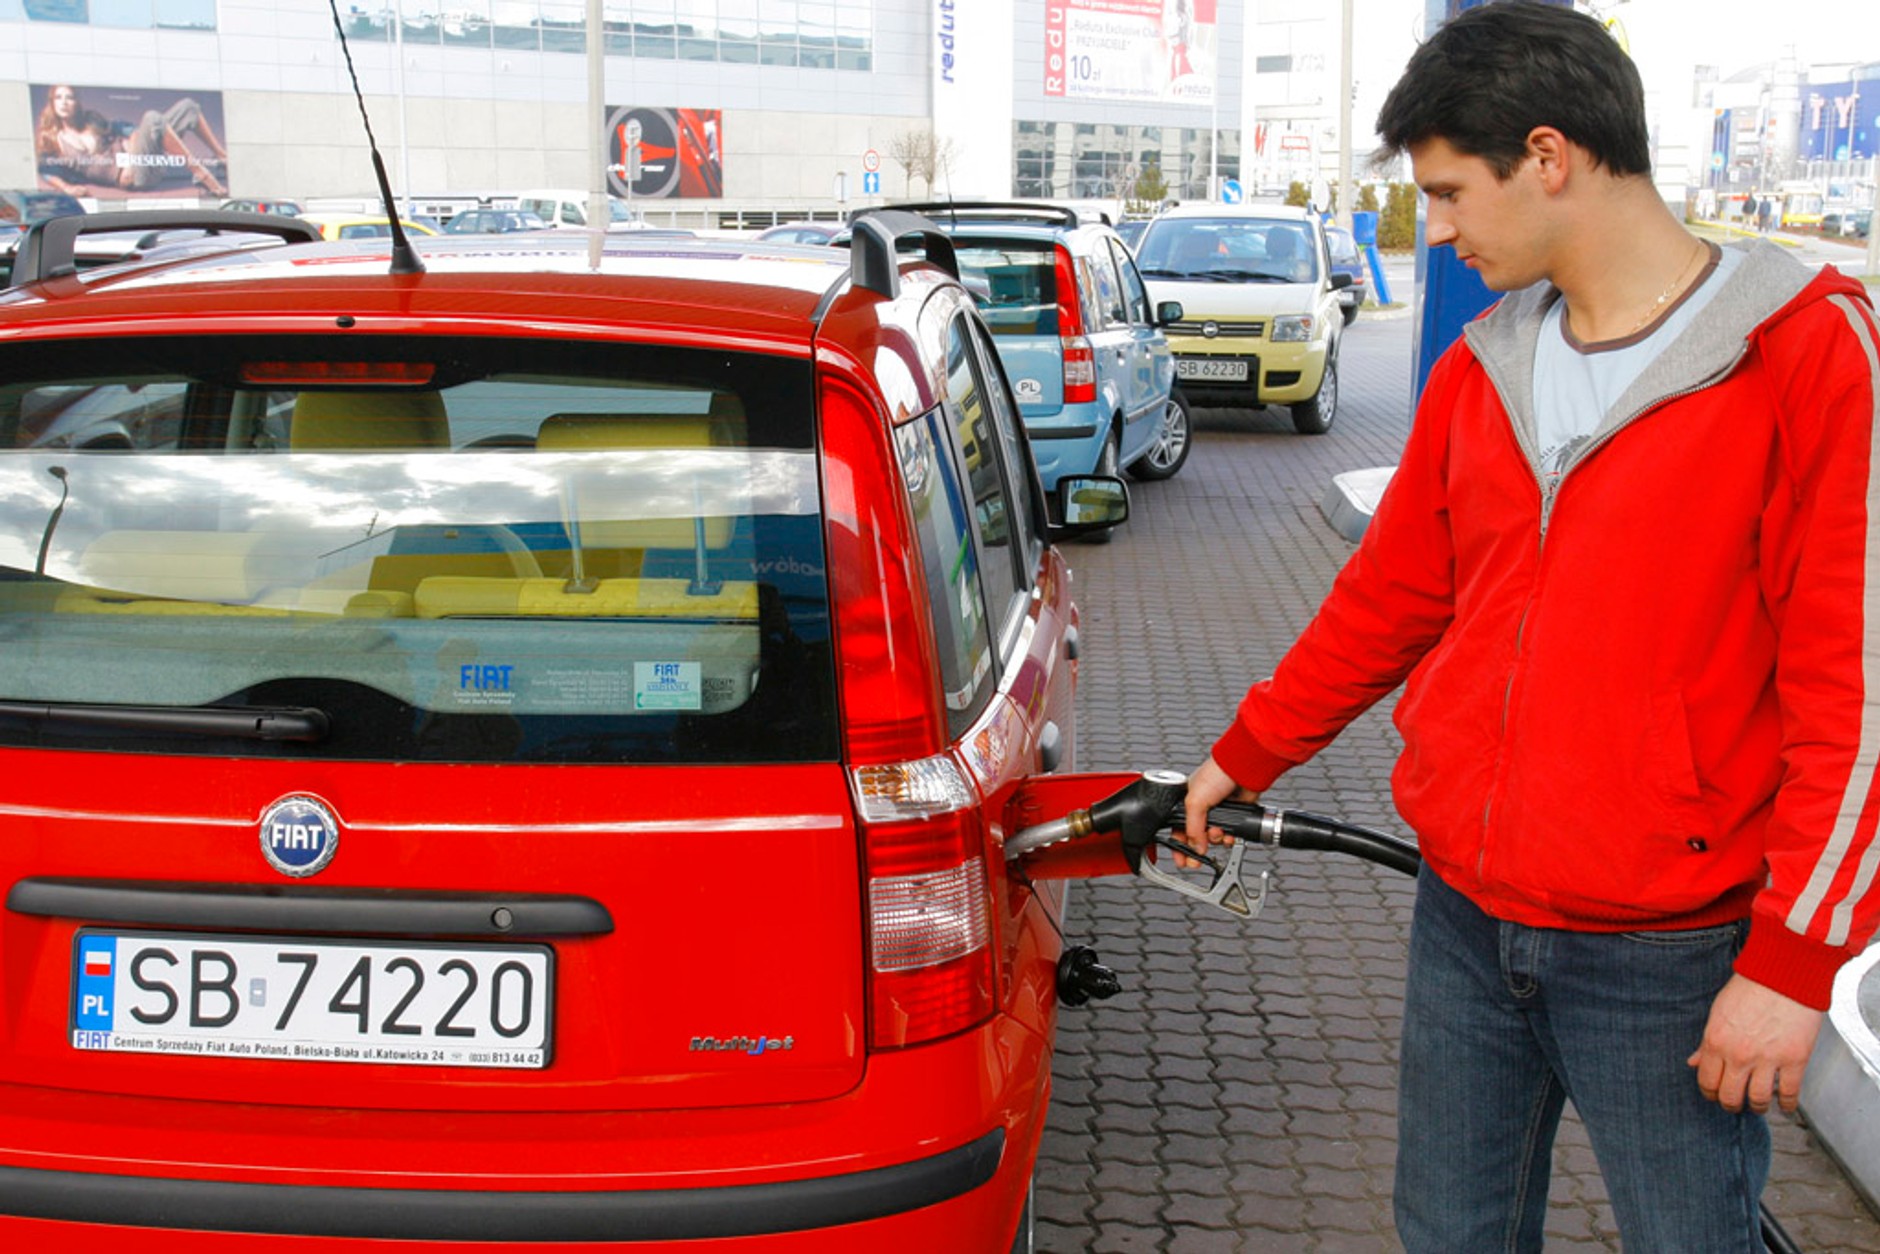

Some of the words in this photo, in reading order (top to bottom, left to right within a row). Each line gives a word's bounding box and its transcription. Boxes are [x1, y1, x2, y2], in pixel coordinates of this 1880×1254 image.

[1070, 54, 1092, 81] 10
[129, 155, 185, 166] RESERVED
[1178, 361, 1198, 375] SB
[1202, 363, 1246, 377] 62230
[1020, 382, 1036, 392] PL
[460, 664, 514, 690] FIAT
[654, 664, 680, 676] FIAT
[271, 824, 323, 849] FIAT
[130, 947, 240, 1028] SB
[275, 952, 533, 1038] 74220
[82, 995, 109, 1016] PL
[76, 1031, 111, 1049] FIAT
[114, 1036, 154, 1047] Centrum
[207, 1041, 225, 1052] Fiat
[229, 1043, 251, 1054] Auto
[255, 1043, 292, 1056] Poland,
[432, 1050, 444, 1061] 24
[492, 1052, 510, 1063] 813
[512, 1053, 525, 1063] 44
[527, 1054, 540, 1064] 42
